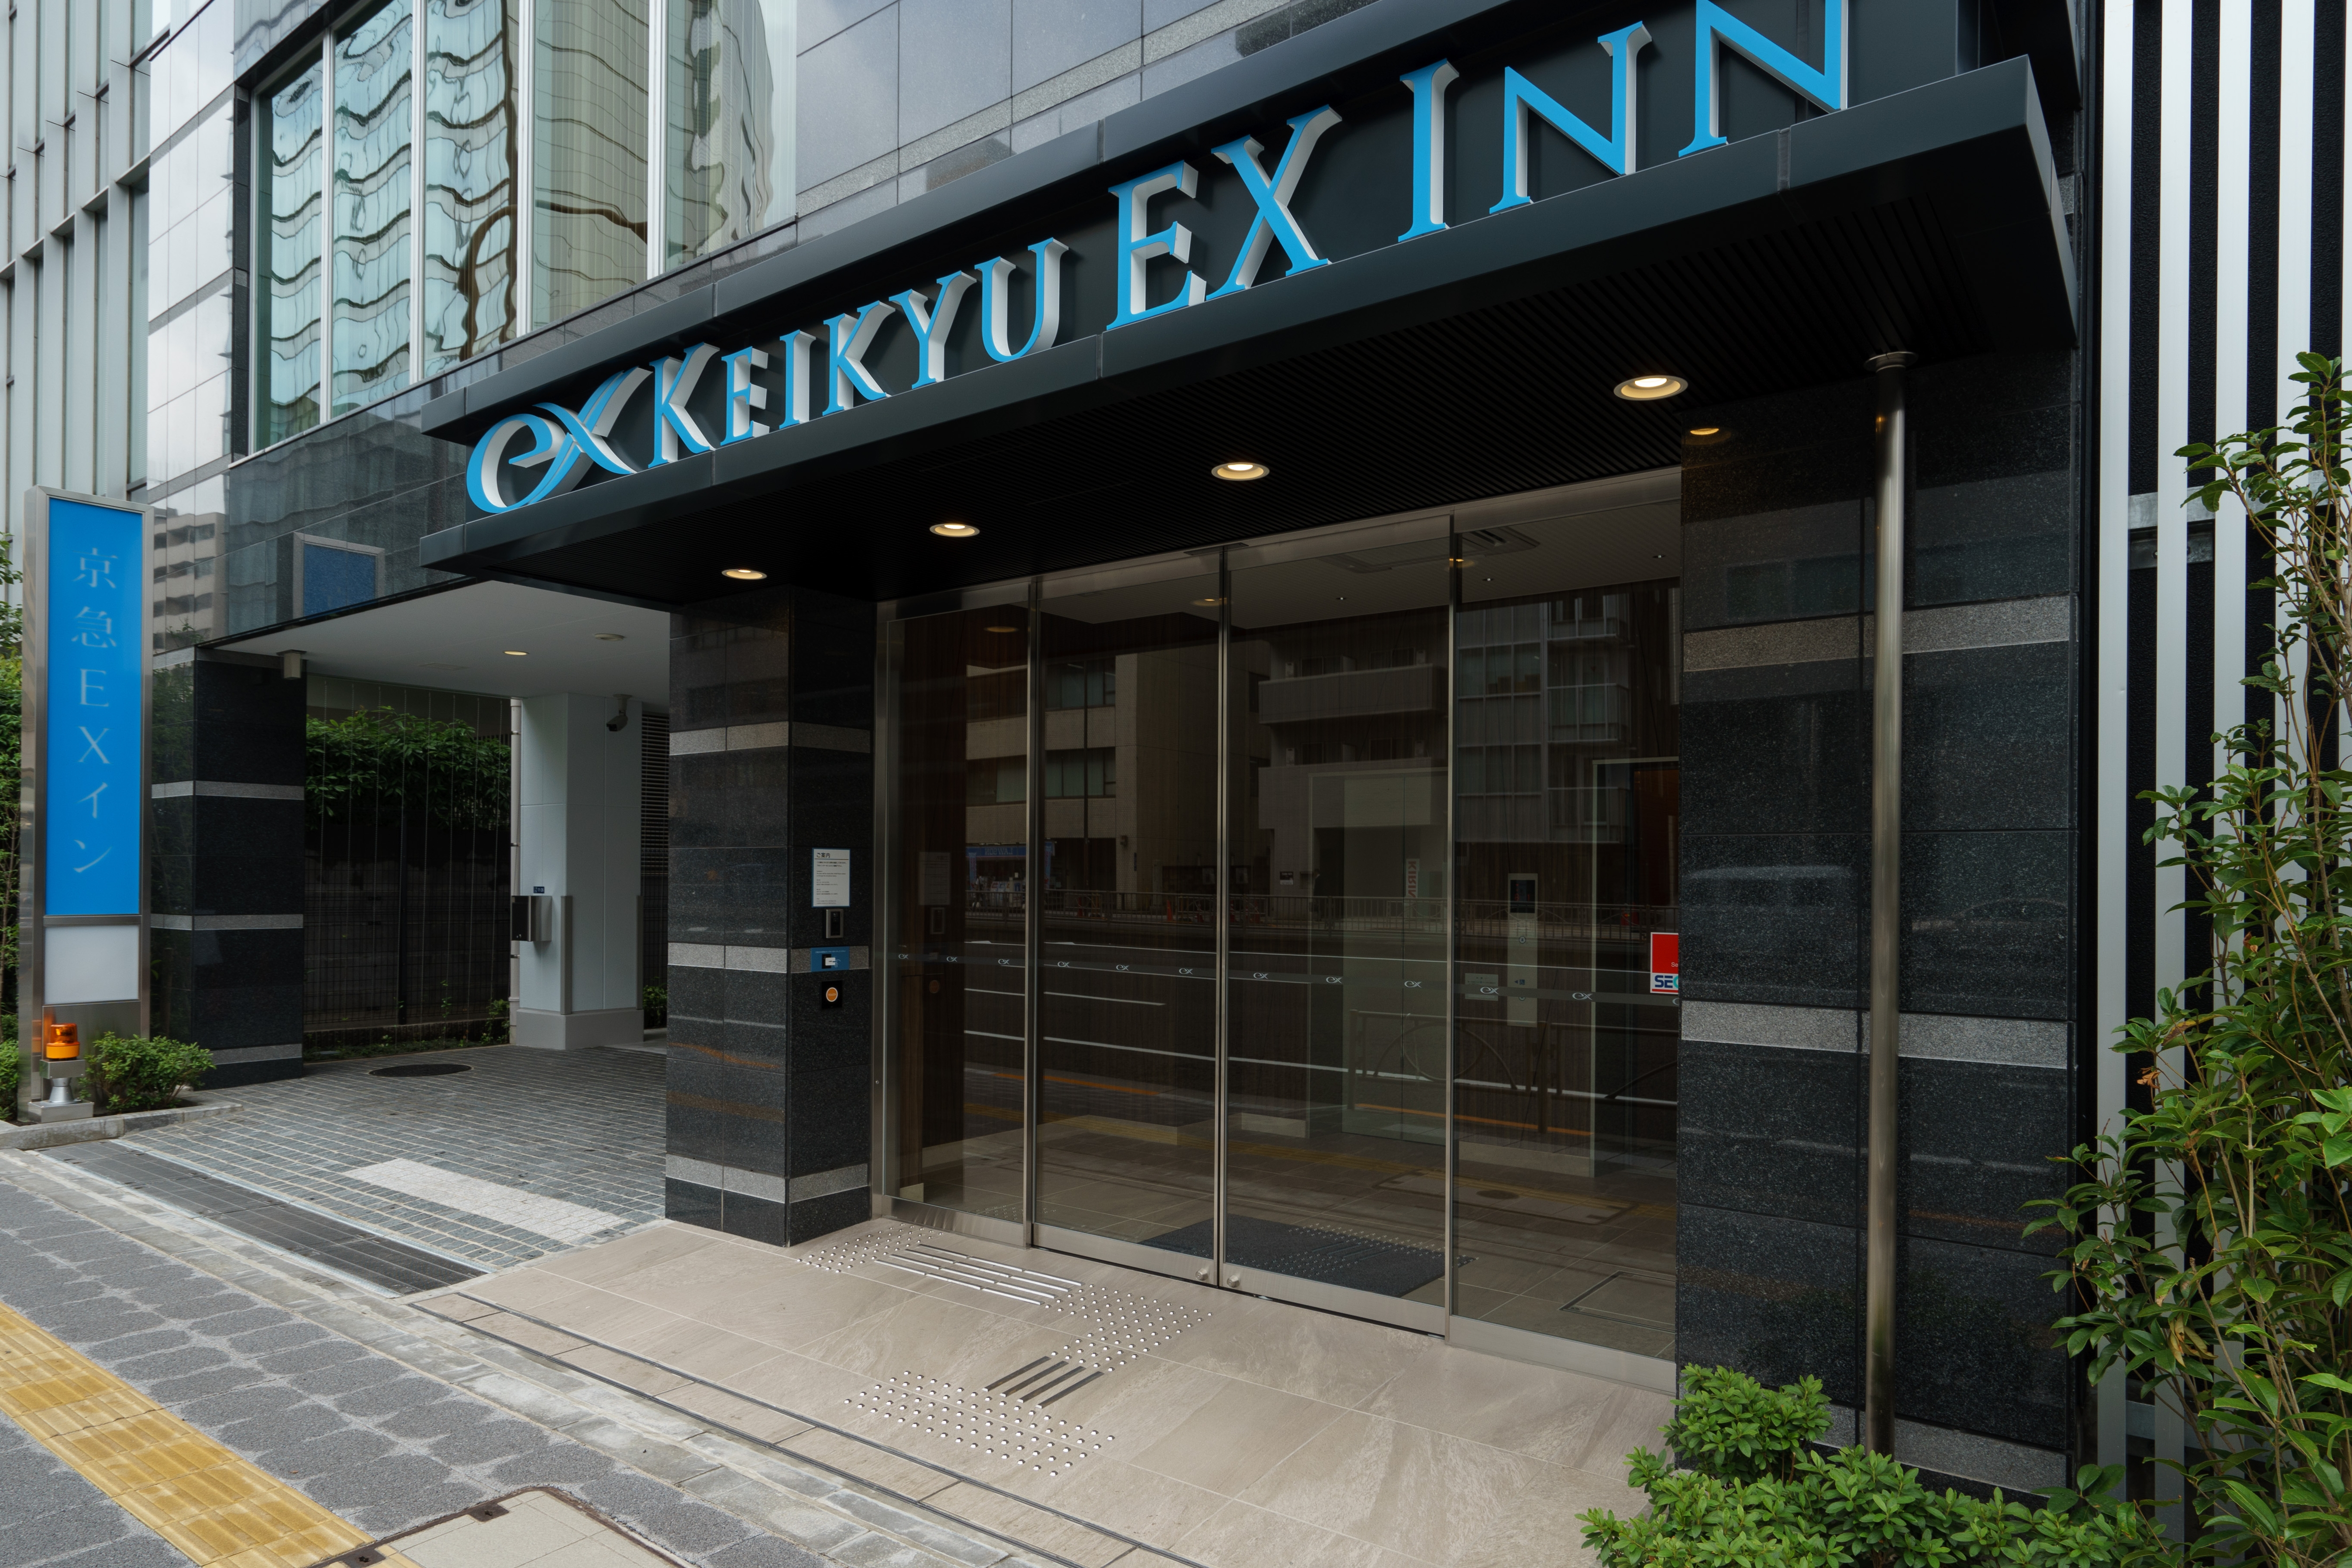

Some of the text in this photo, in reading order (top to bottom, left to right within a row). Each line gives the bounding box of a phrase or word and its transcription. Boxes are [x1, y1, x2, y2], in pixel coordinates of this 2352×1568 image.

[648, 237, 1069, 469] KEIKYU
[1106, 105, 1341, 331] EX
[1398, 0, 1849, 243] INN
[71, 546, 119, 875] 京急EXイン
